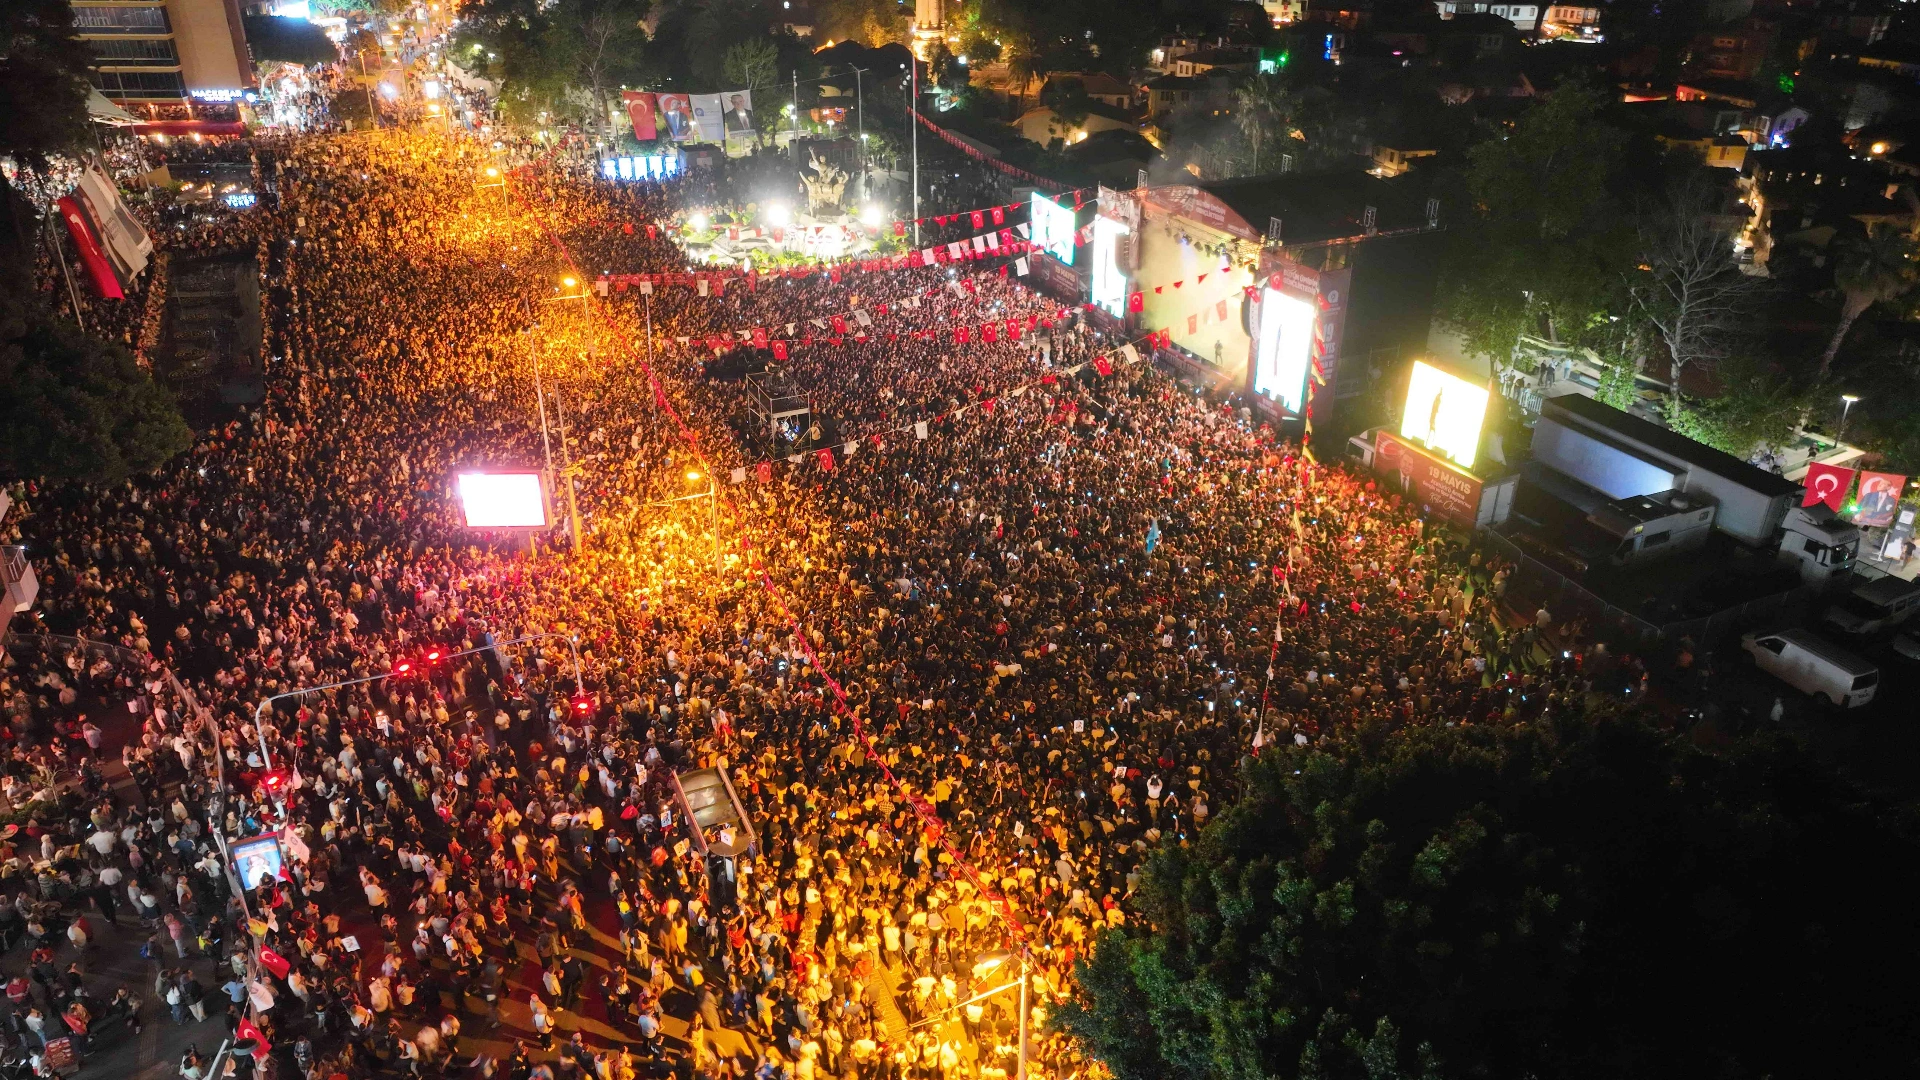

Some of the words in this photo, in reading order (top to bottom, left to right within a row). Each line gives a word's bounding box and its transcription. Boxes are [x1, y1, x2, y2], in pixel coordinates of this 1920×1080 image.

[71, 14, 111, 27] atırım
[1428, 466, 1440, 478] 19
[1441, 471, 1472, 495] MAYIS
